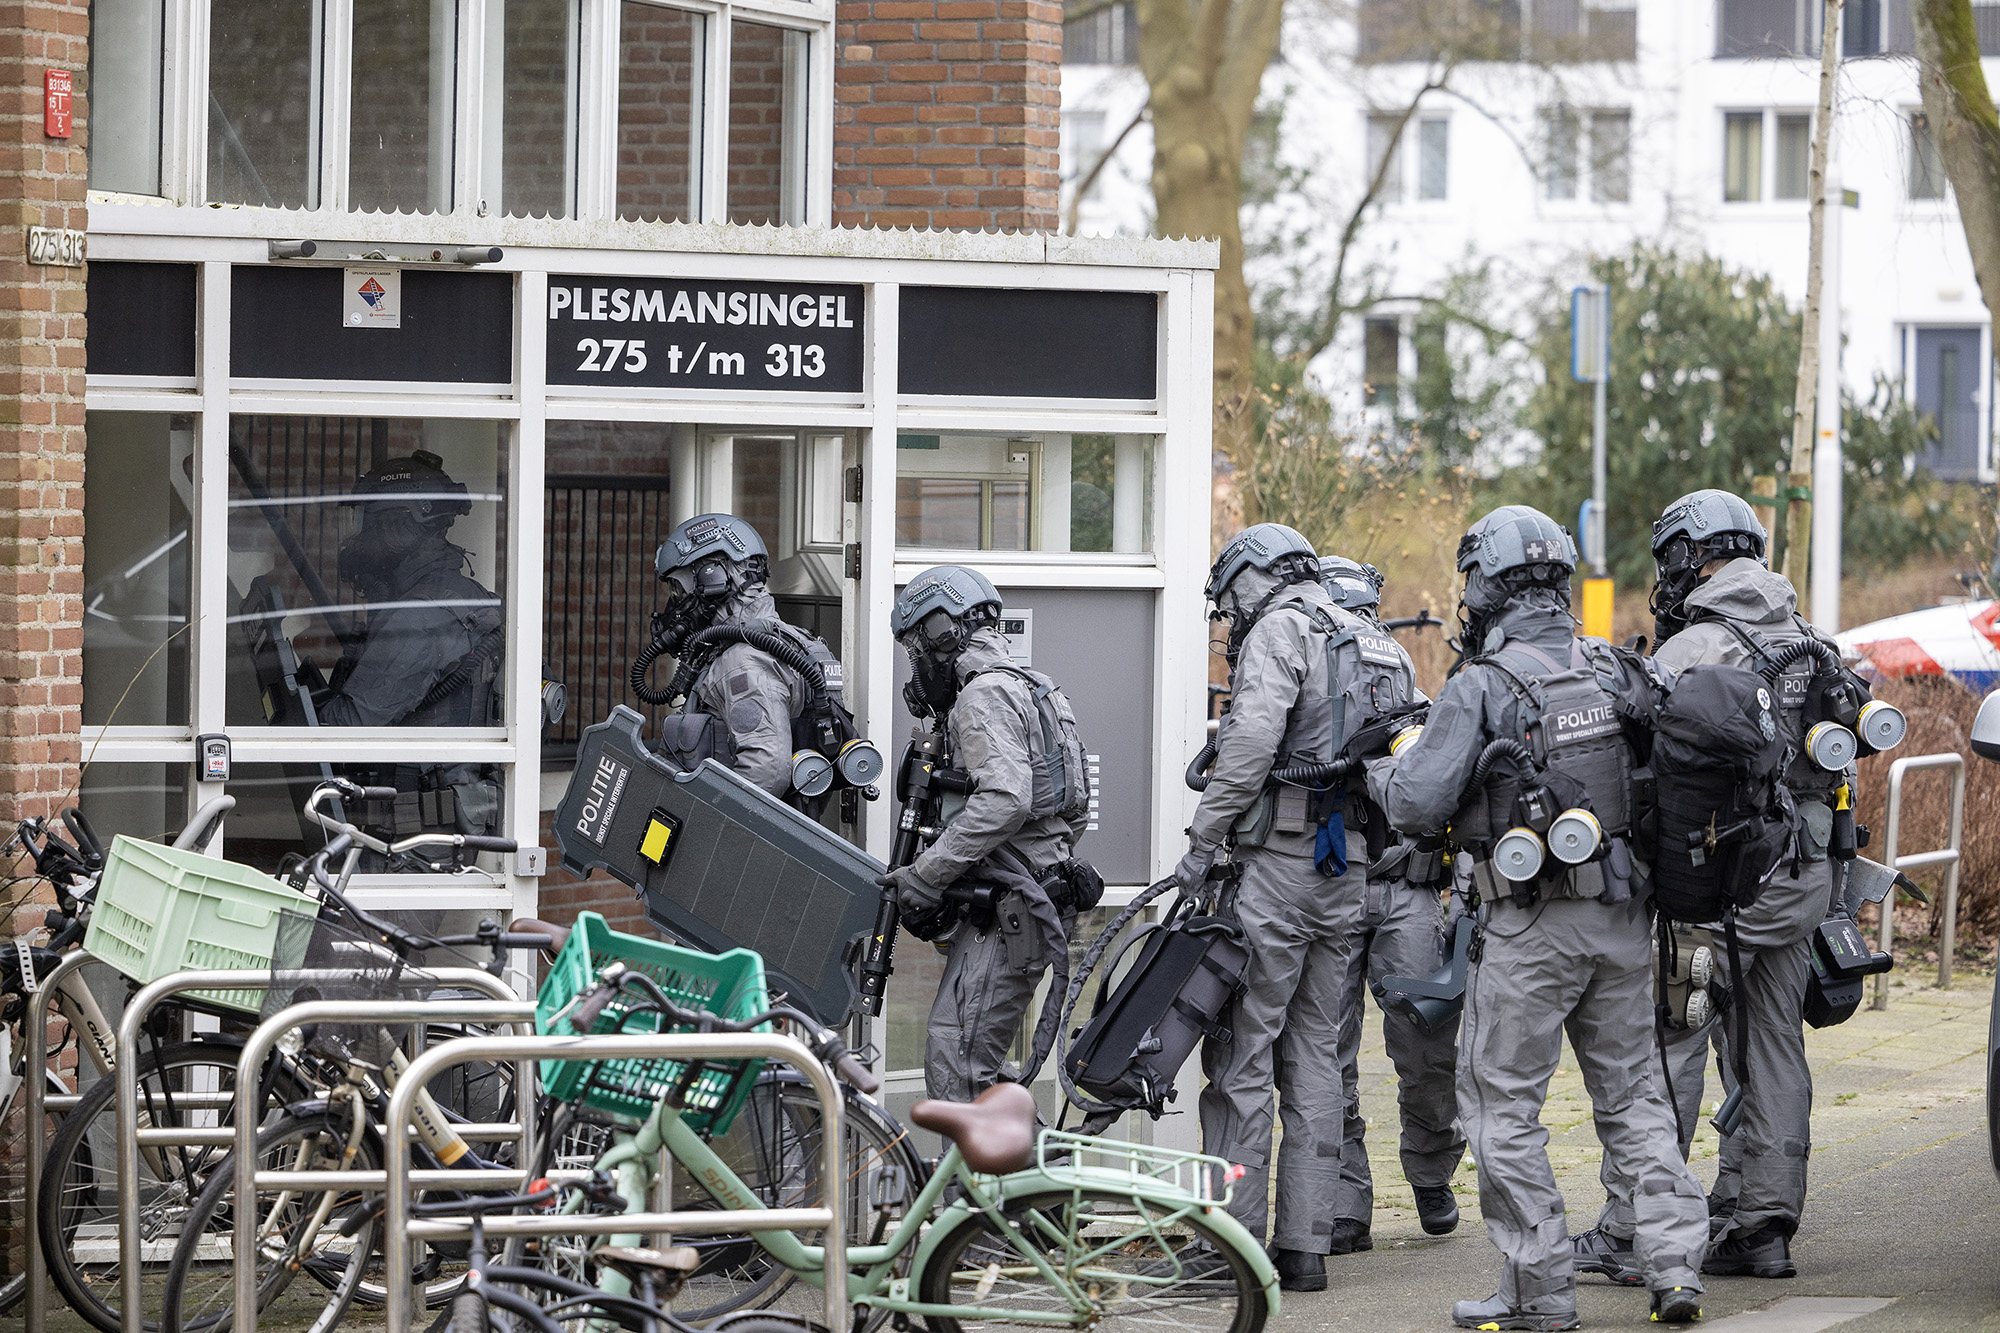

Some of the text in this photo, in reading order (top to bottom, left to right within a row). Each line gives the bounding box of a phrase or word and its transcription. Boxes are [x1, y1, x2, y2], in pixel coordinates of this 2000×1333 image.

[48, 78, 72, 92] B31346
[48, 97, 57, 109] 15
[57, 116, 63, 128] 2
[549, 286, 854, 328] PLESMANSINGEL
[576, 338, 826, 378] 275 t/m 313
[380, 473, 412, 482] POLITIE
[686, 520, 716, 535] POLITIE
[906, 575, 936, 595] POLITIE
[1357, 636, 1398, 655] POLITIE
[1557, 704, 1615, 730] POLITIE
[576, 756, 617, 837] POLITIE
[87, 1020, 117, 1067] GIANT
